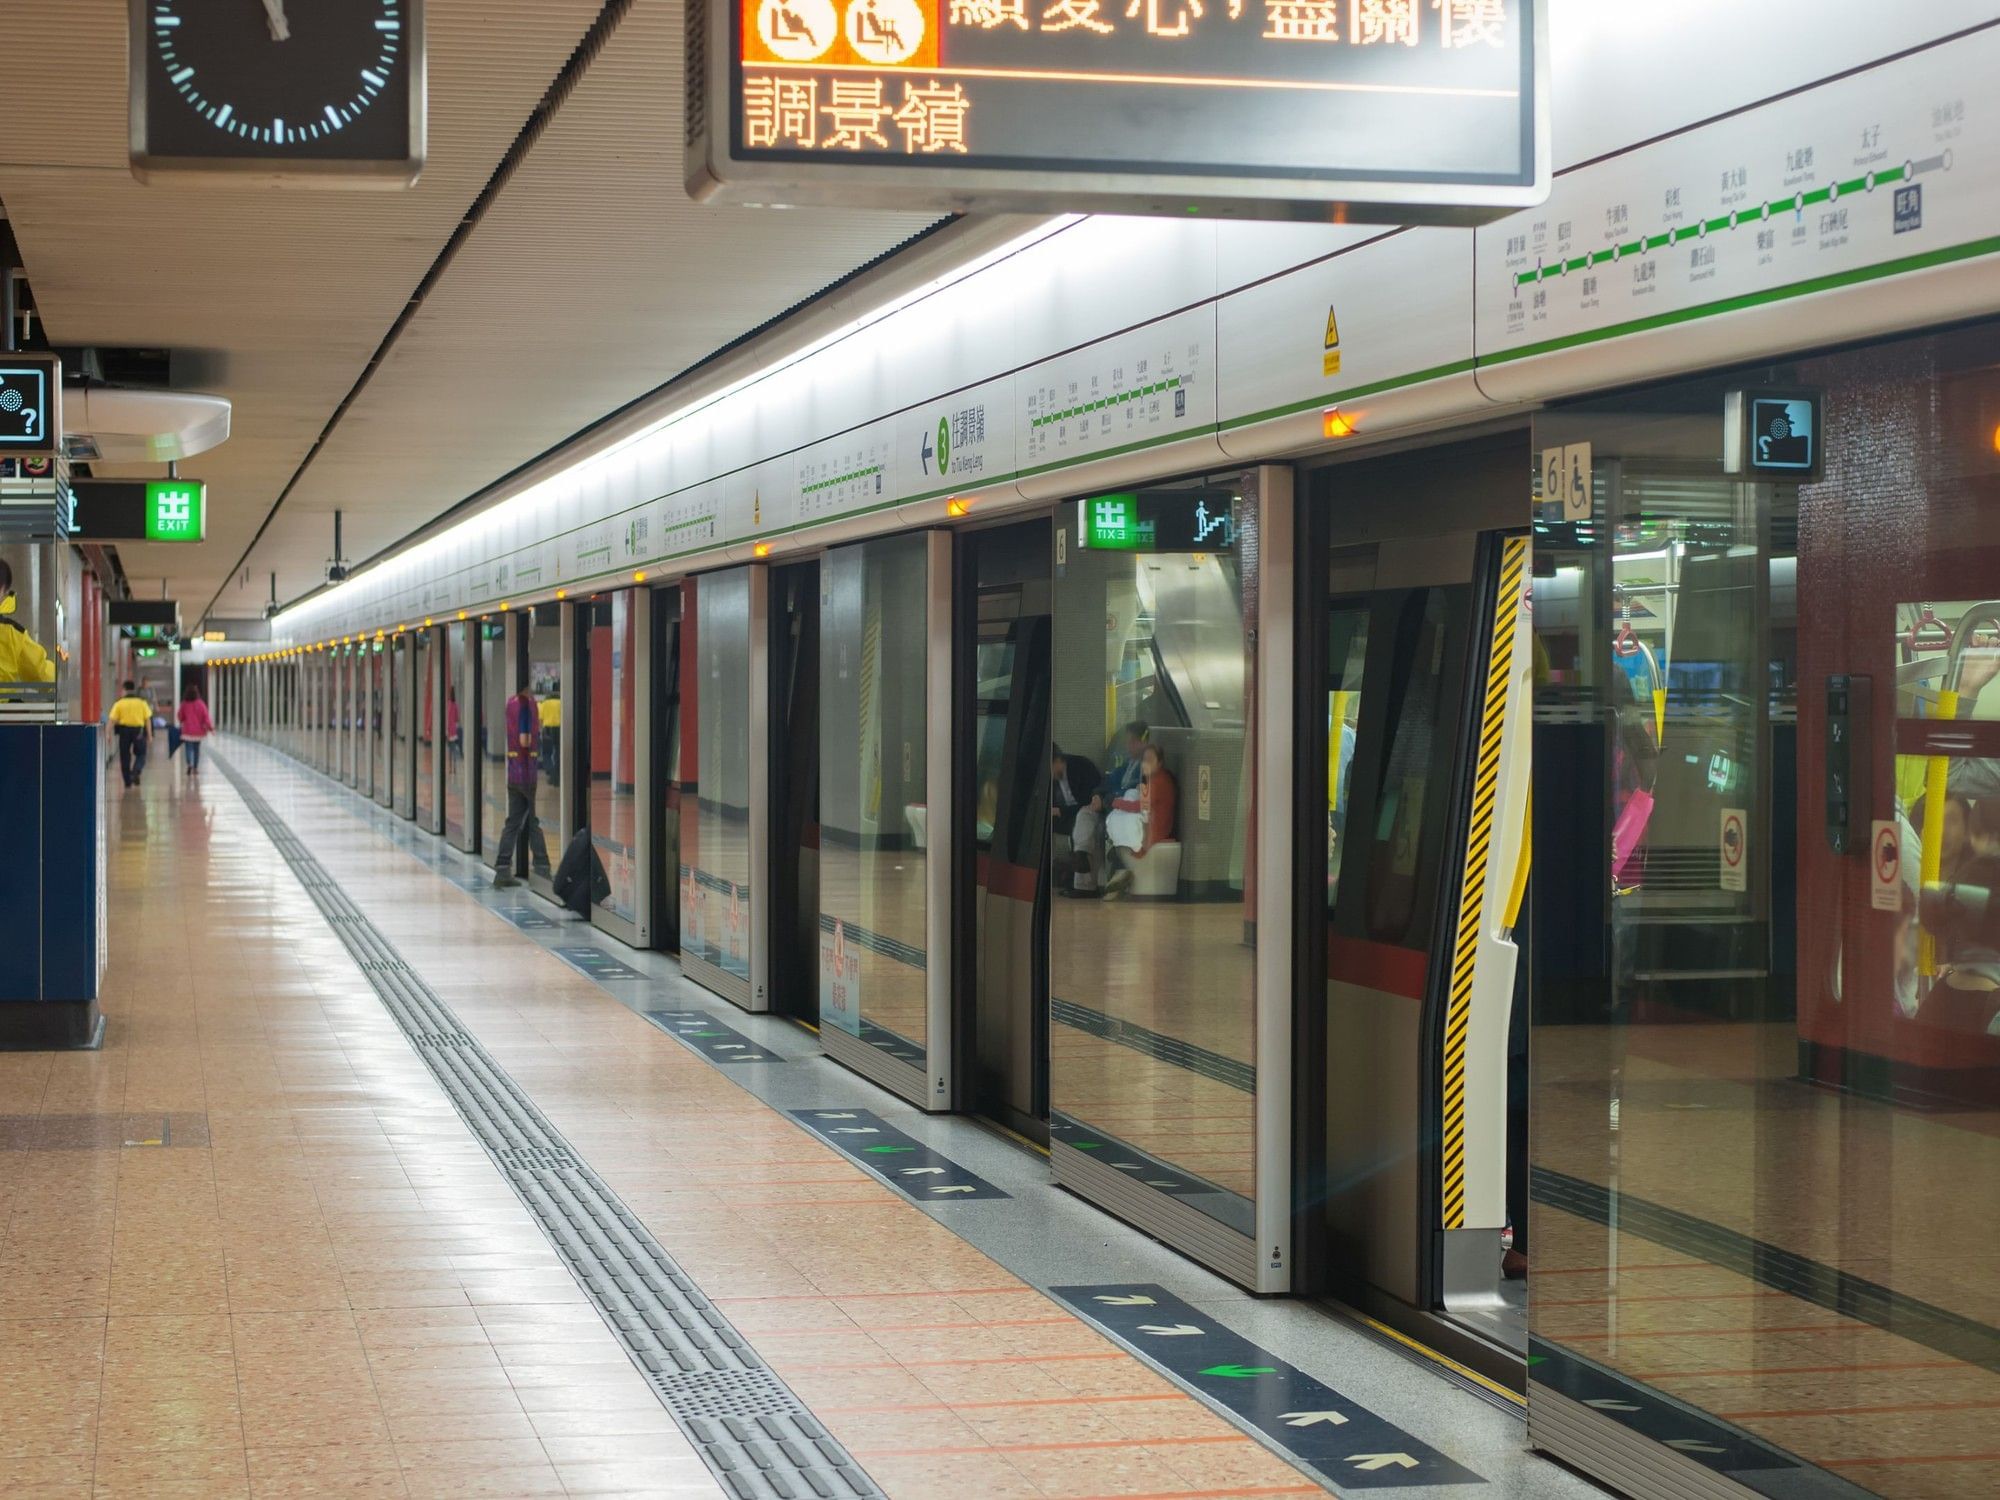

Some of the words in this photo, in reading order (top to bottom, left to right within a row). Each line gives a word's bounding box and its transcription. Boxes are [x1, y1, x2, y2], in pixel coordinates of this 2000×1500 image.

[743, 77, 970, 153] 調景嶺
[1547, 456, 1558, 496] 6
[157, 519, 189, 531] EXIT
